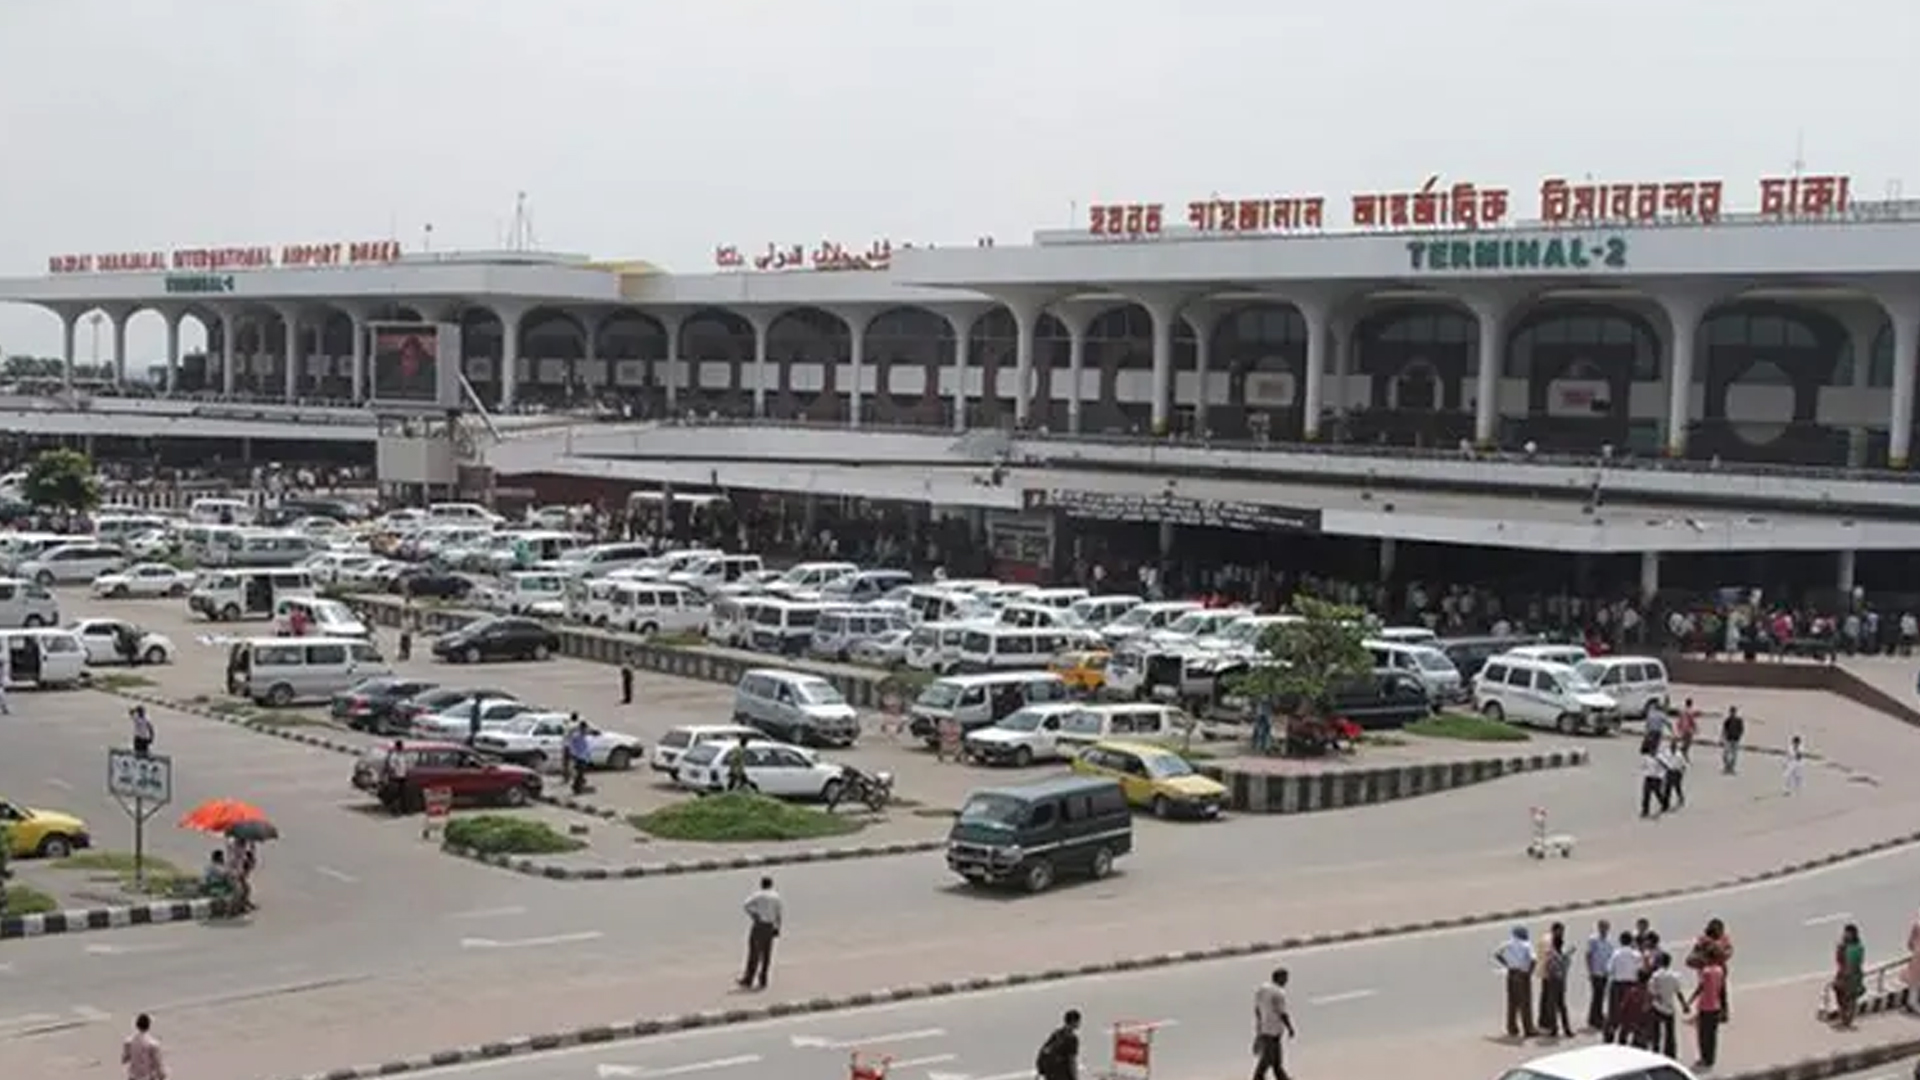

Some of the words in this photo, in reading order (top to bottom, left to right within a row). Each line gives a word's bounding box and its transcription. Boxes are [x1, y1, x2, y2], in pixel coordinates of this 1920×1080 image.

[1089, 204, 1164, 235] হযরত
[1188, 197, 1324, 231] শাহজালাল
[1541, 179, 1722, 223] বিমানবন্দর
[1760, 176, 1850, 215] ঢাকা
[282, 243, 342, 264] AIRPORT
[1407, 238, 1627, 271] TERMINAL-2
